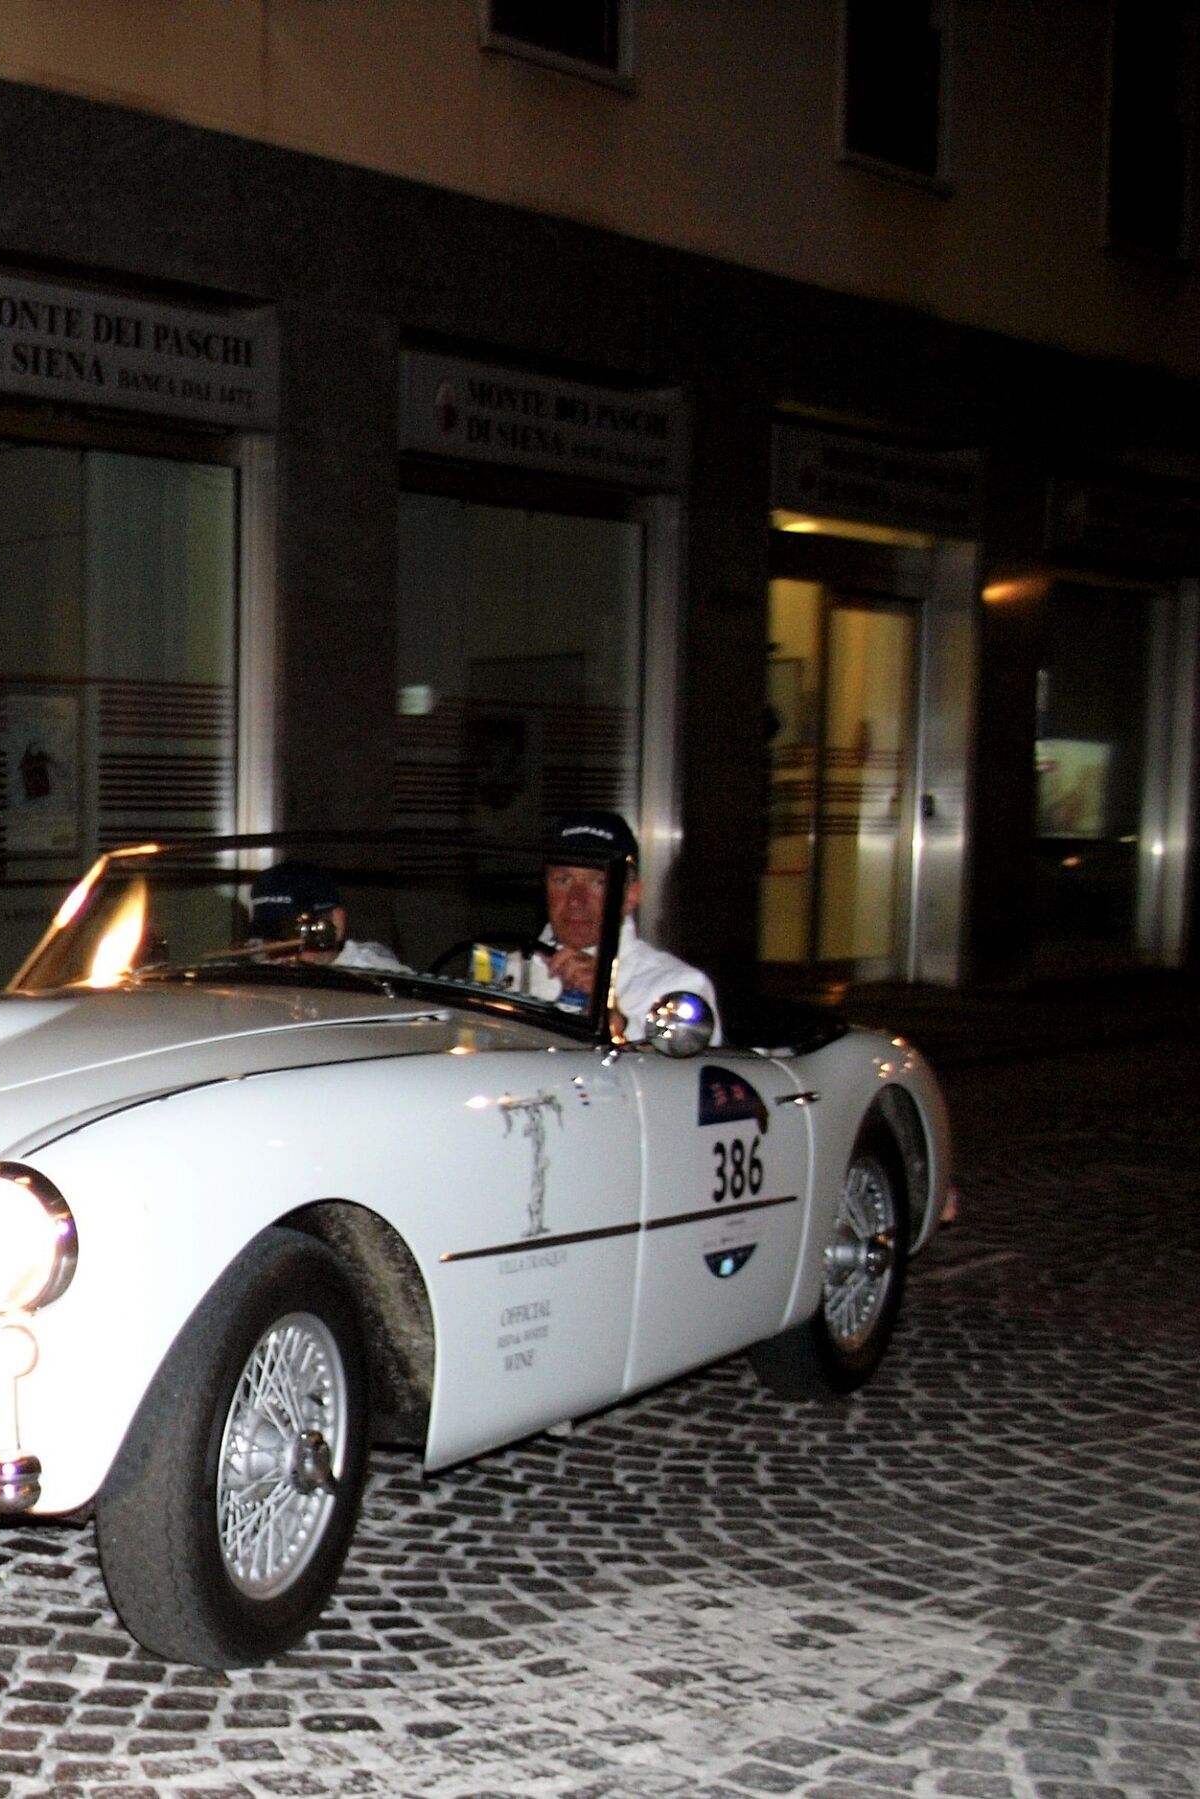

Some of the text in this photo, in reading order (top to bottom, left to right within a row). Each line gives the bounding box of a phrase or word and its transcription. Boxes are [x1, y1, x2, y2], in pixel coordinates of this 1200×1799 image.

[93, 312, 142, 349] DEI
[153, 324, 254, 368] PASCHI
[11, 342, 104, 386] SIENA
[118, 369, 176, 396] BANCA
[712, 1134, 764, 1202] 386
